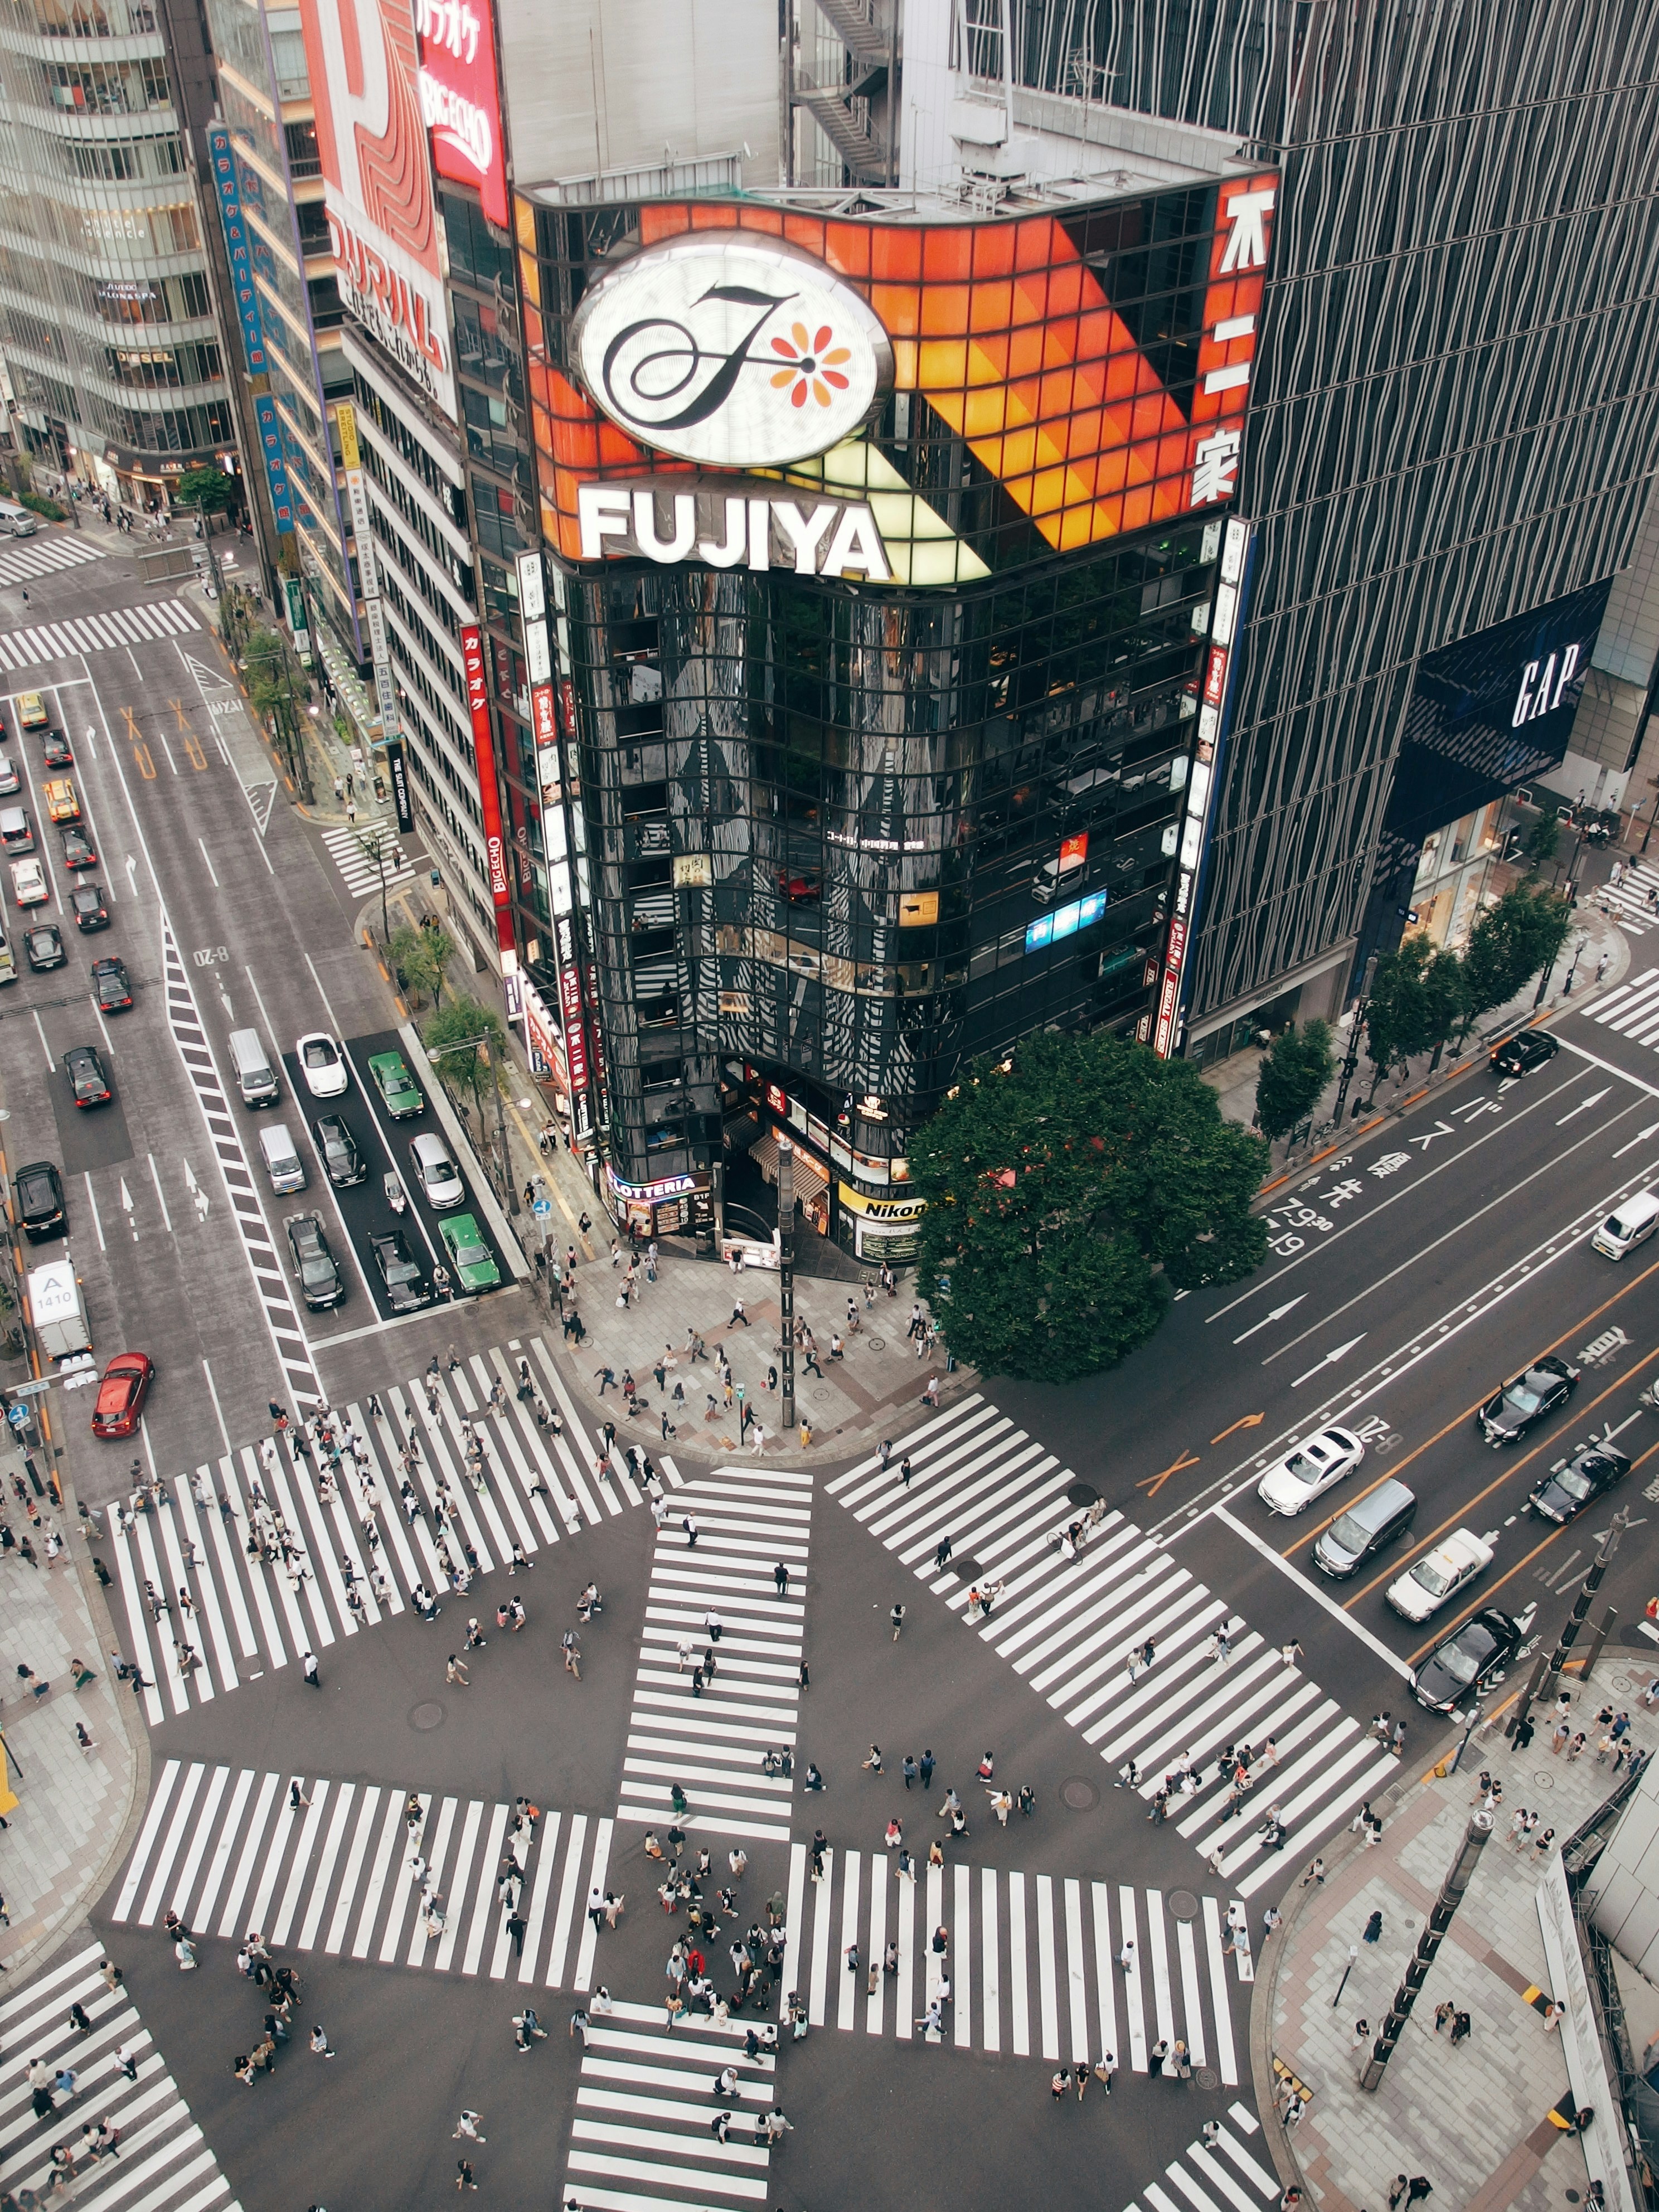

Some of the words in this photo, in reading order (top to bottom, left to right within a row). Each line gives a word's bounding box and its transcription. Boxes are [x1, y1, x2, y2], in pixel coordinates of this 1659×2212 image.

[117, 352, 174, 363] DIESEL
[1190, 190, 1275, 507] 不二家
[339, 410, 351, 457] BREITLING
[345, 408, 355, 442] STUDIO
[261, 410, 290, 519] カラオケ館
[578, 488, 892, 580] FUJIYA
[464, 636, 487, 711] カラオケ
[1512, 644, 1579, 727] GAP
[393, 758, 401, 773] THE
[395, 773, 405, 788] SUIT
[397, 788, 409, 819] COMPANY
[193, 946, 229, 967] 8-20
[569, 977, 579, 1005] 不二家
[1162, 978, 1175, 1016] REGAL
[1157, 1019, 1169, 1054] SHOES
[570, 1033, 584, 1075] 不二家
[579, 1100, 589, 1131] LOTTERIA
[613, 1177, 695, 1199] LOTTERIA
[693, 1192, 710, 1201] B1F
[865, 1202, 926, 1217] Nikon
[43, 1277, 62, 1292] A
[37, 1292, 72, 1310] 1410
